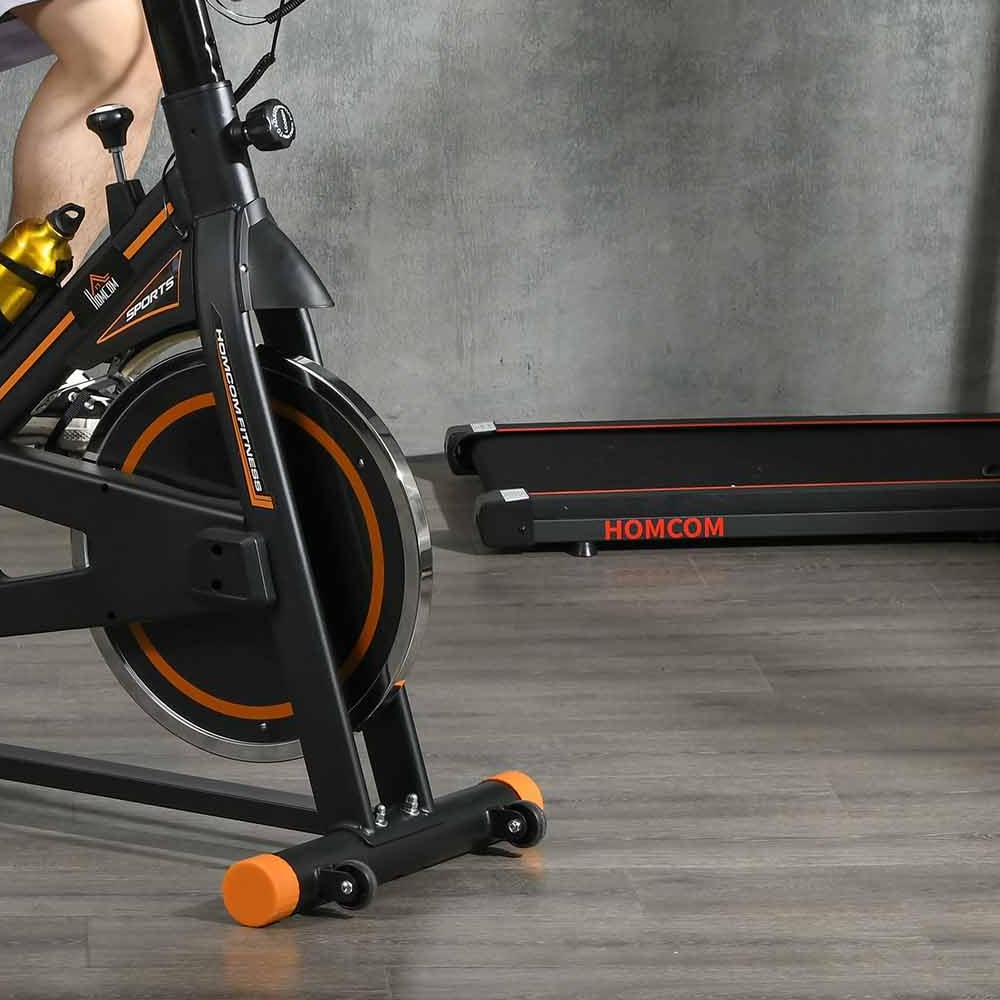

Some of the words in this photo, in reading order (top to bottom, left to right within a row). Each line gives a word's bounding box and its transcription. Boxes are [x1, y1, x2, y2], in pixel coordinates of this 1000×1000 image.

[125, 275, 175, 322] SPORTS
[215, 328, 242, 415] HOMCOM
[237, 416, 263, 492] FITNESS
[604, 516, 725, 541] HOMCOM
